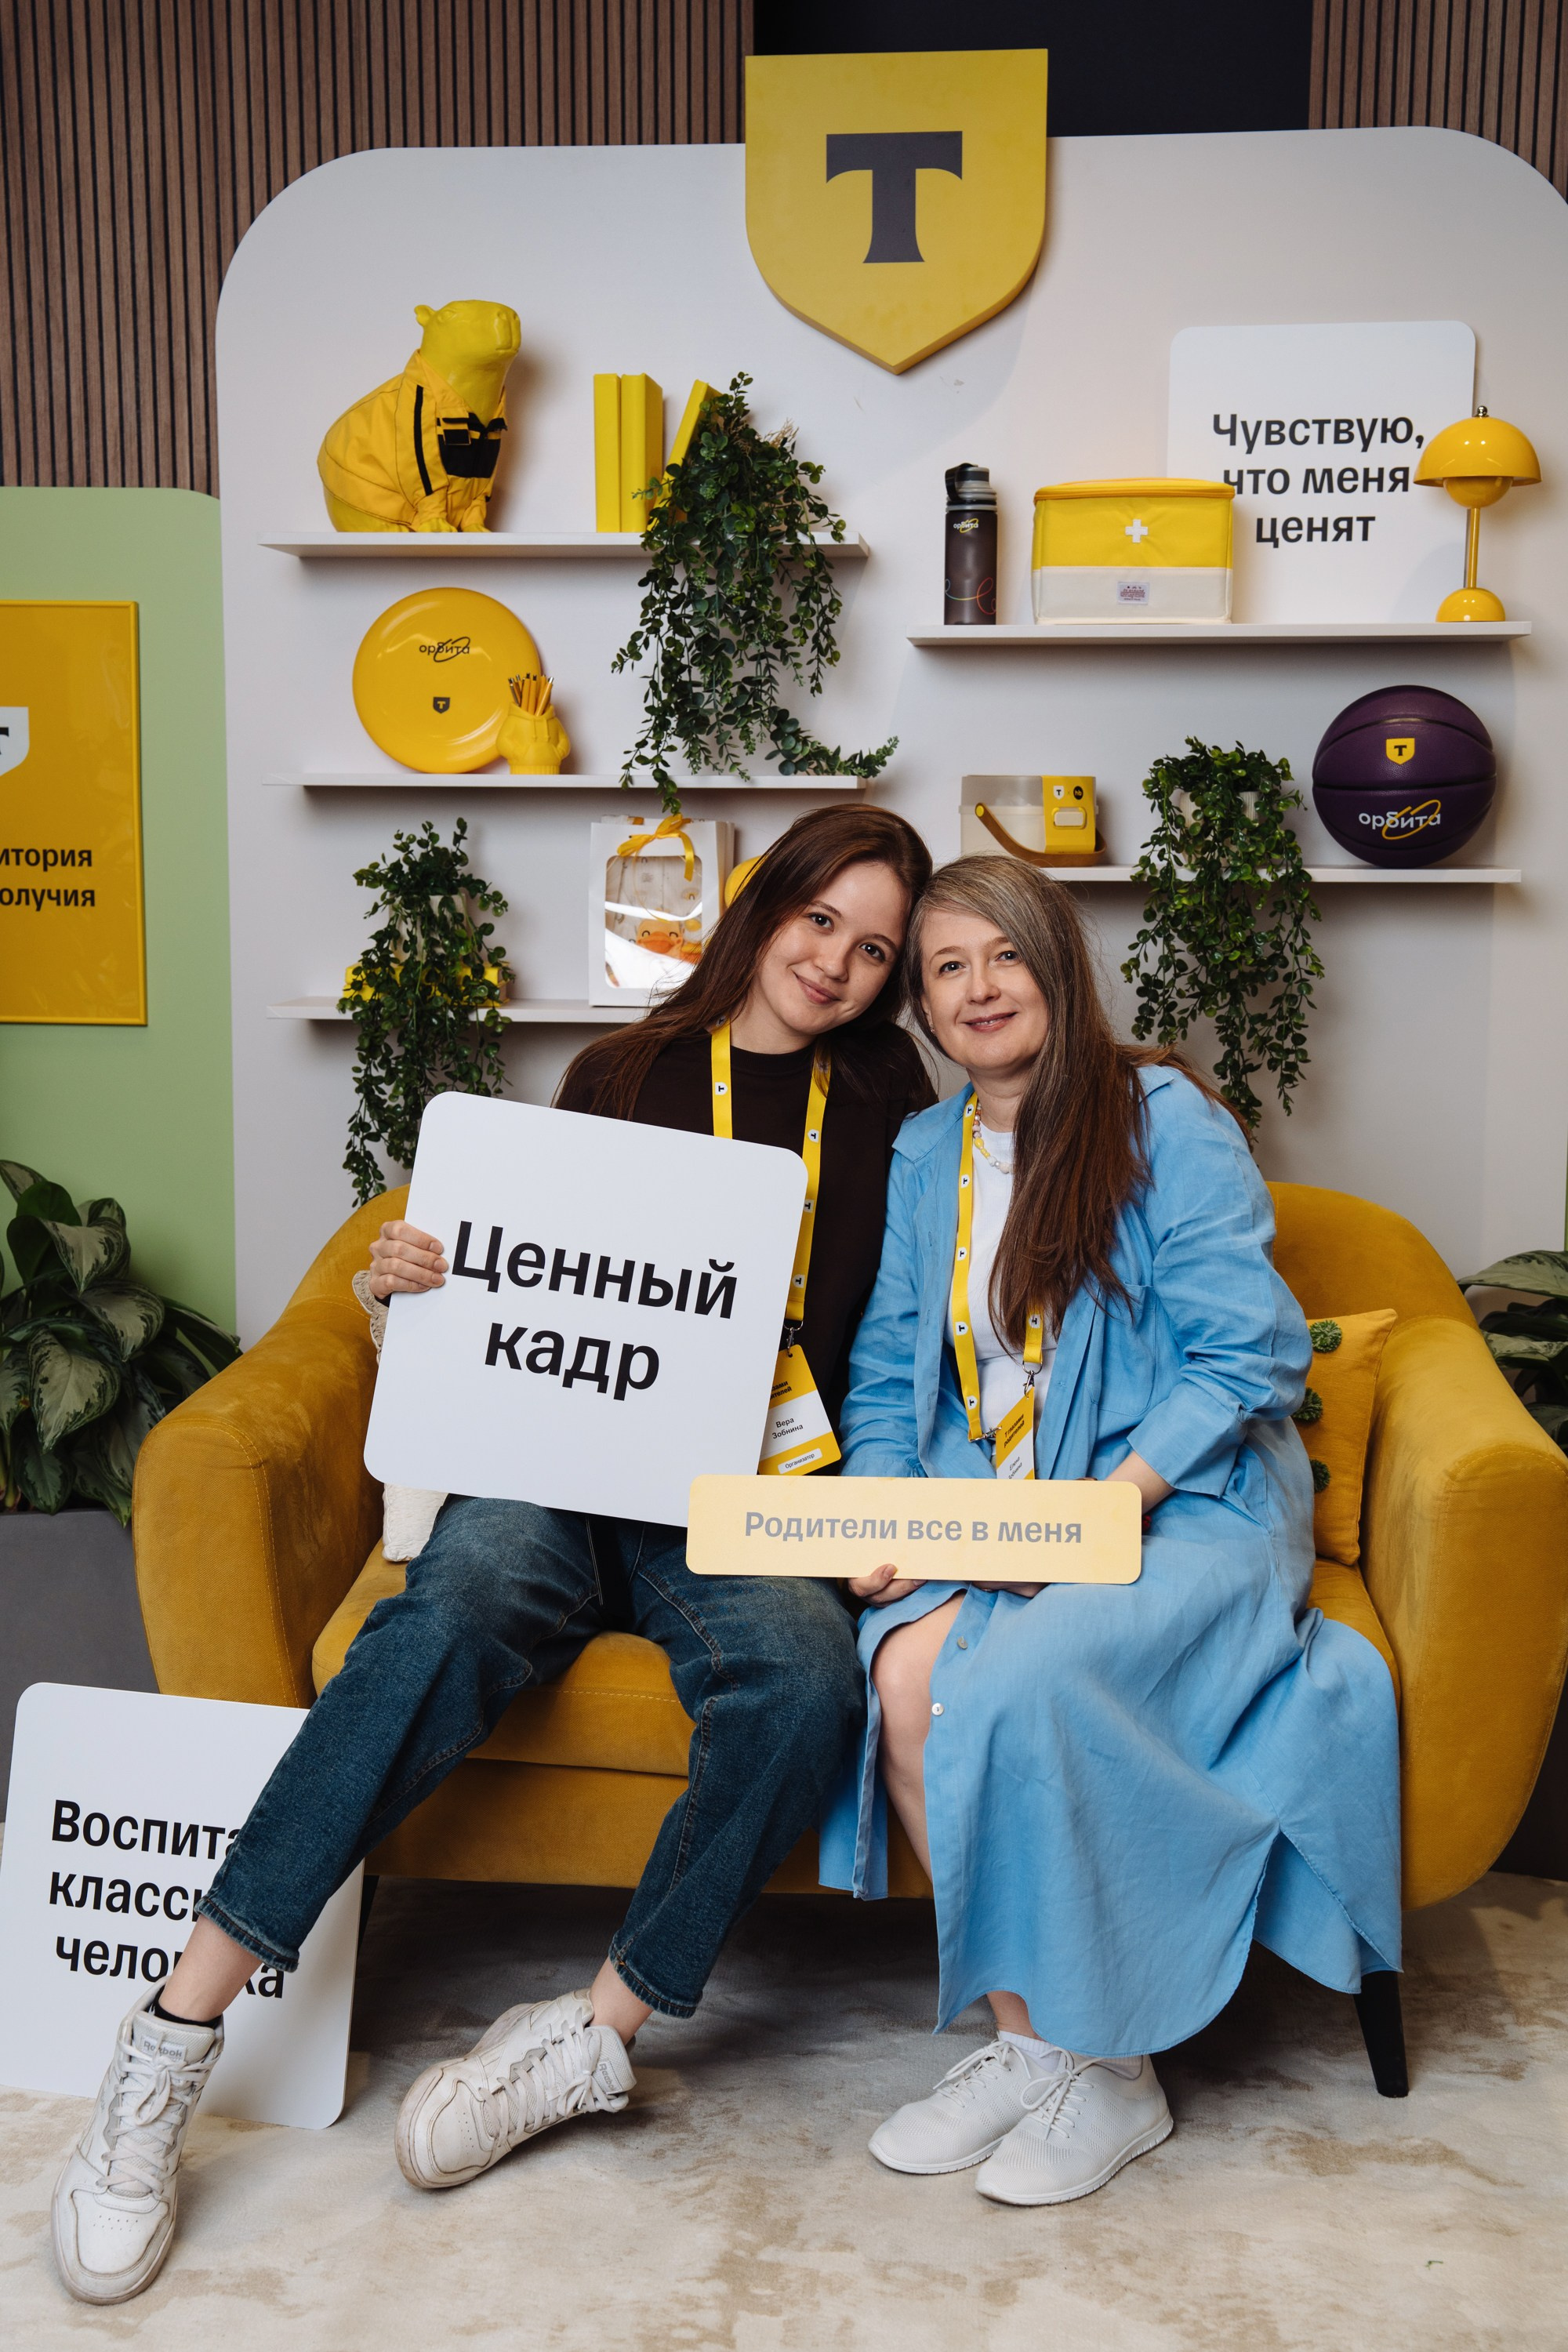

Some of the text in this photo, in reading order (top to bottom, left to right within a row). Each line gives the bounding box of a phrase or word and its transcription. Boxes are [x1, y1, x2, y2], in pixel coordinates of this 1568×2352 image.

[1213, 414, 1425, 454] Чувствую,
[1223, 466, 1410, 495] что меня
[1256, 516, 1376, 548] ценят
[419, 641, 470, 657] орбита
[1359, 809, 1441, 831] орбита
[0, 887, 96, 912] олучия
[452, 1221, 737, 1319] Ценный
[485, 1323, 659, 1401] кадр
[771, 1424, 804, 1439] Зобнина
[775, 1417, 795, 1428] Вера
[785, 1453, 815, 1469] Организатор
[745, 1512, 1083, 1544] Родители все в меня
